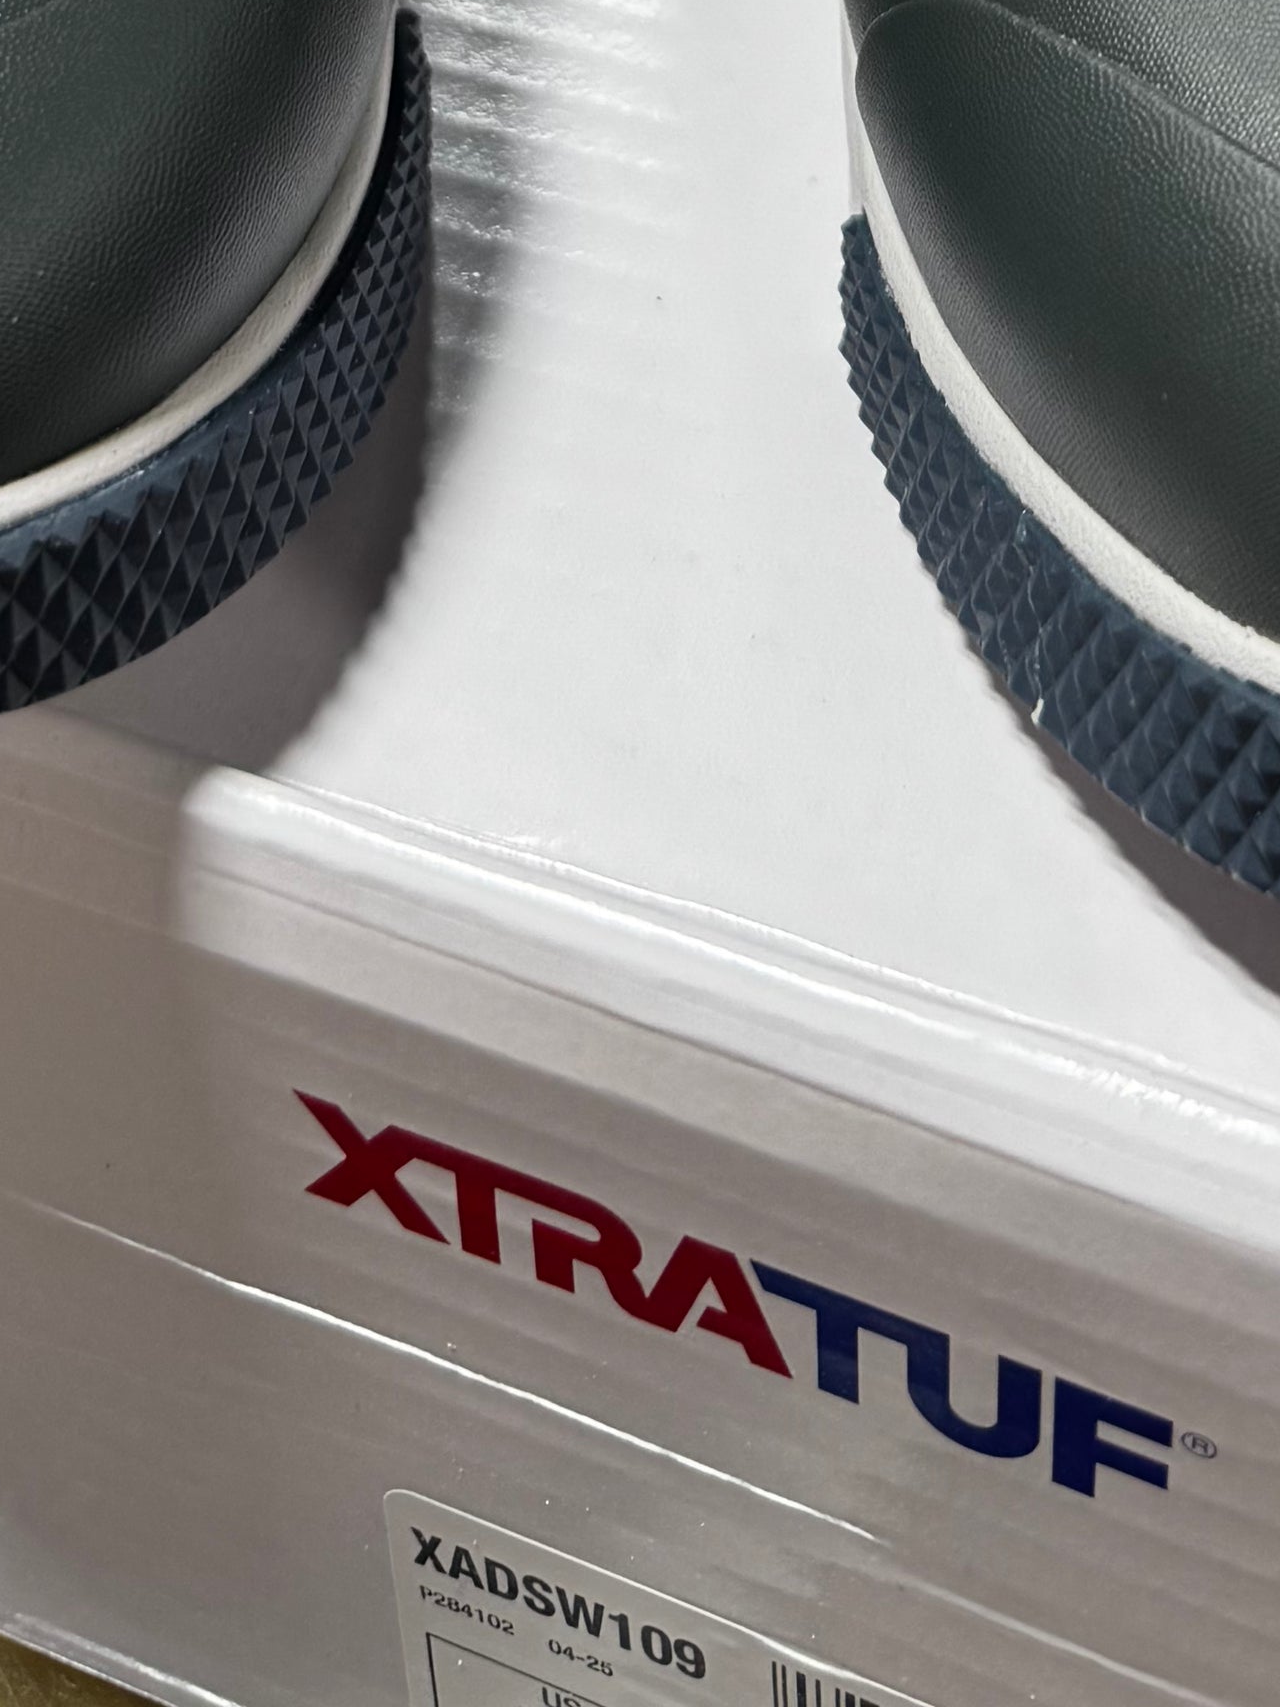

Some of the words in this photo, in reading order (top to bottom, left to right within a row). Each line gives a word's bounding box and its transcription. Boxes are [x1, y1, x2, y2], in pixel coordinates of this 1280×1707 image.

[411, 1526, 707, 1680] XADSW109
[420, 1585, 515, 1636] P284102
[548, 1639, 614, 1677] 04-25
